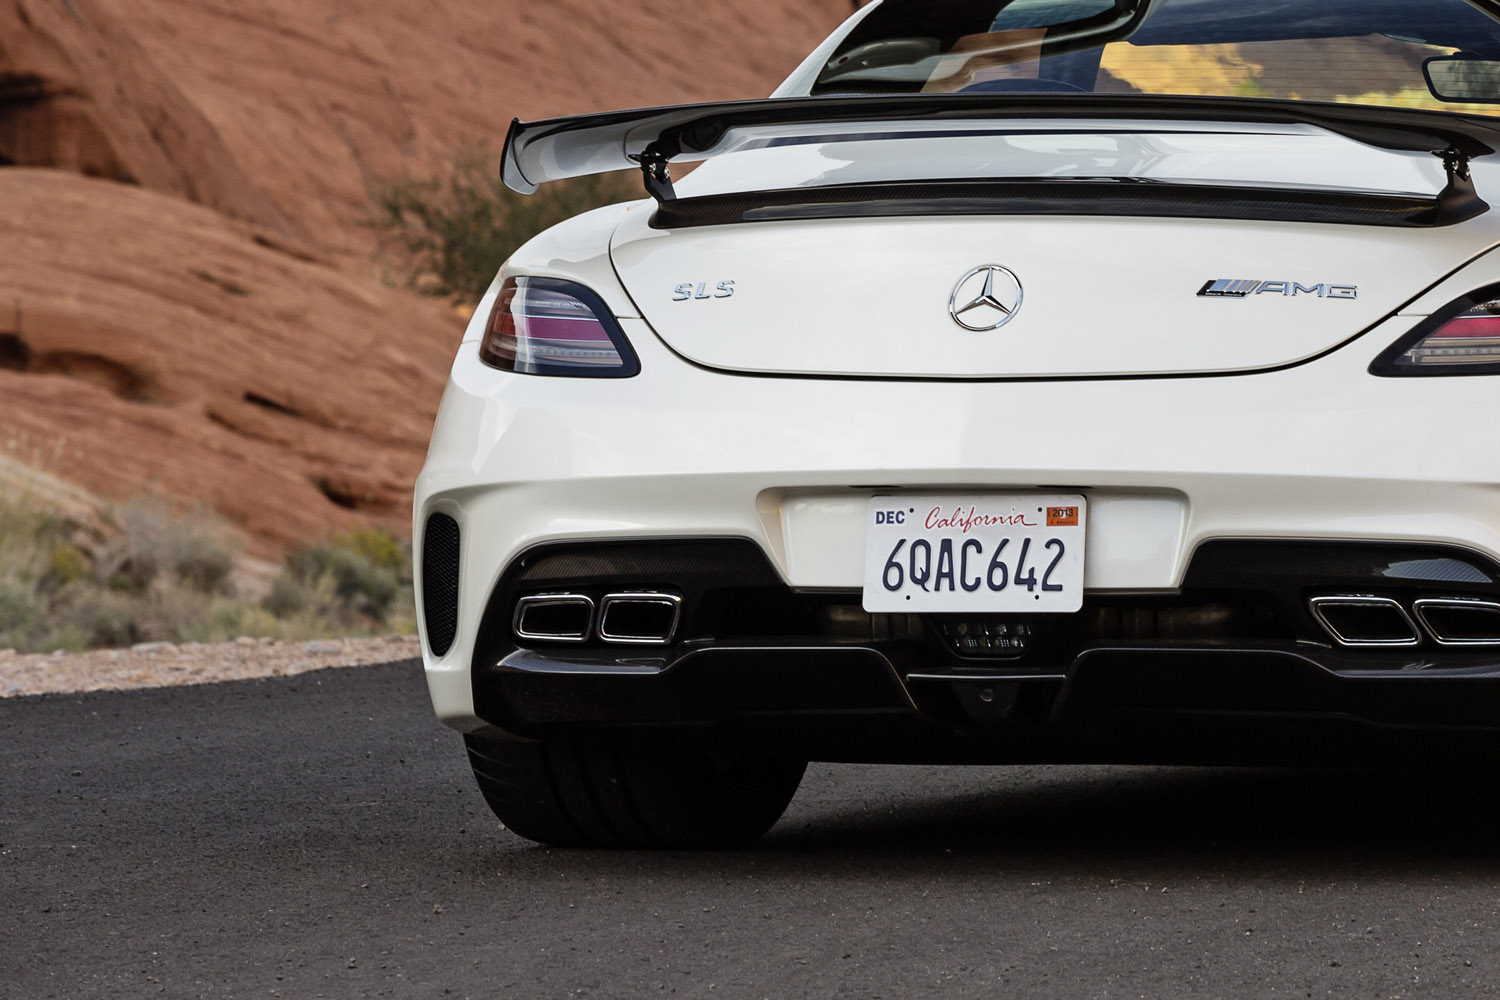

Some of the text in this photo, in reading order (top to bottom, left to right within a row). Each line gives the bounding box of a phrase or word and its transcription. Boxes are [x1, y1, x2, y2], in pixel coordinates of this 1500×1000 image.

[672, 279, 736, 300] SLS
[1255, 280, 1358, 299] AMG
[875, 510, 905, 525] DEC
[925, 506, 1038, 533] California
[1052, 508, 1074, 518] 2013
[882, 538, 1065, 592] 6QAC642
